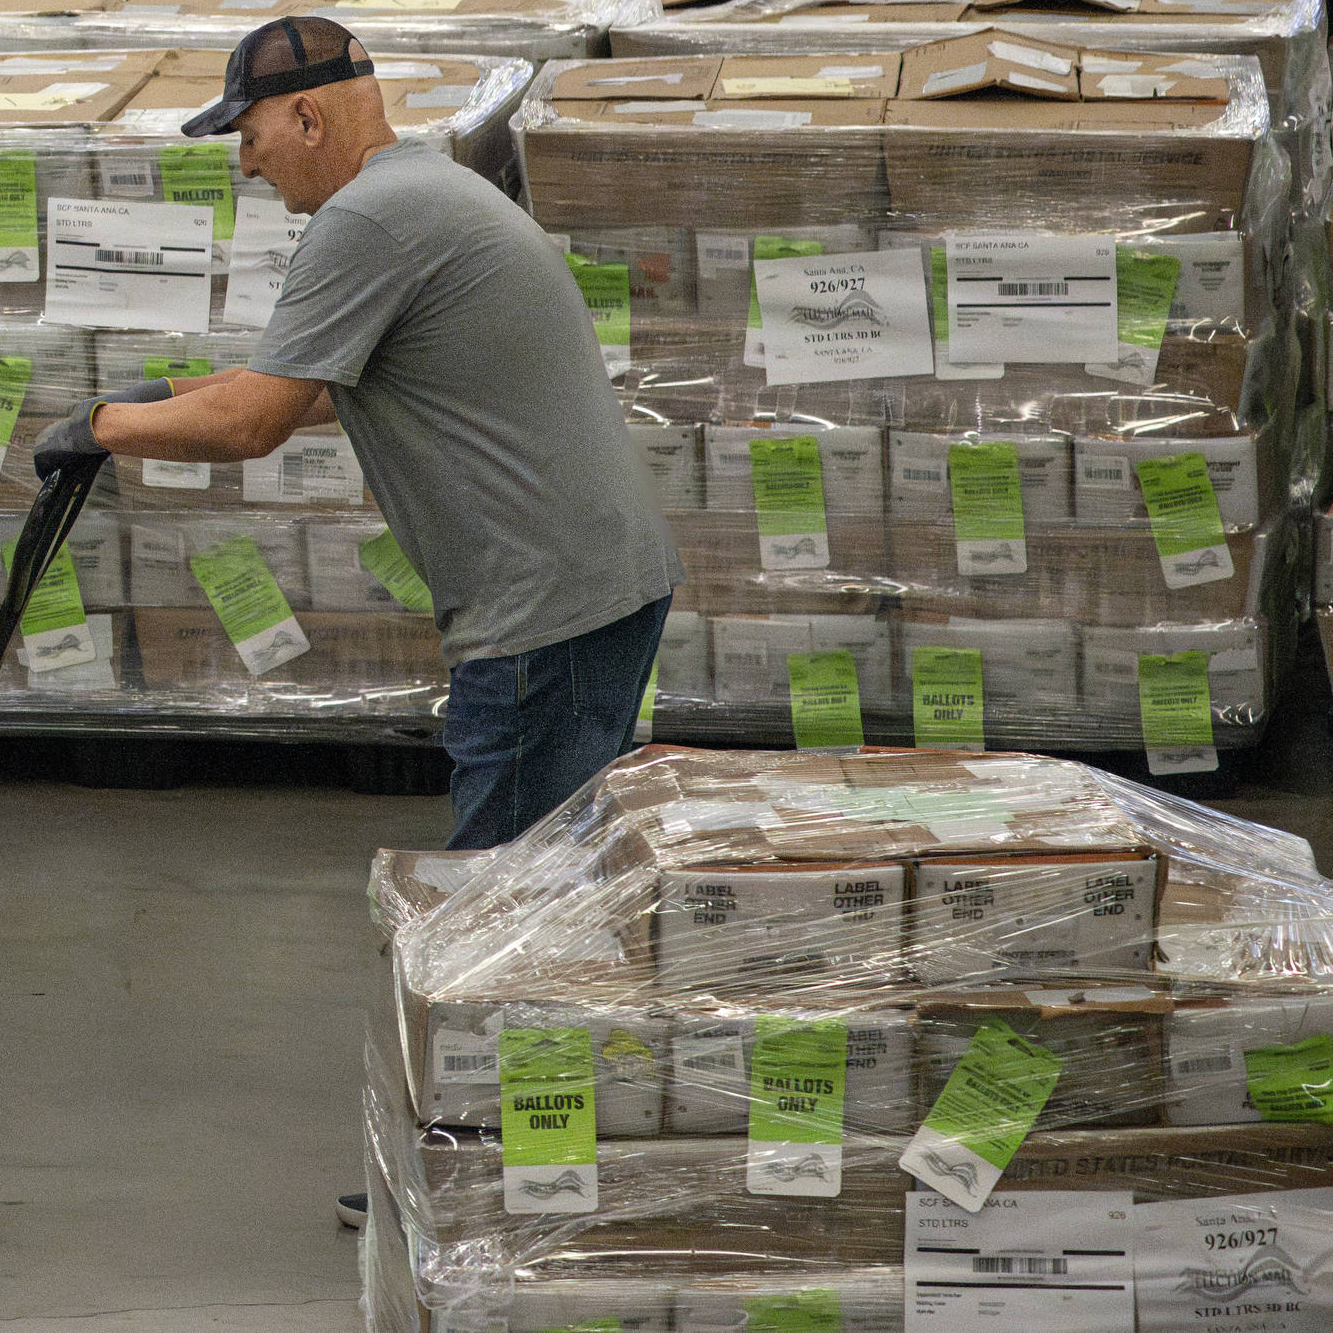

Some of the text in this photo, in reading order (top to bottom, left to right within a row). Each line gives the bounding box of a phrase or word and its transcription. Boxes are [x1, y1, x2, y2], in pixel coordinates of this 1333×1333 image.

[172, 189, 224, 202] BALLOTS
[73, 204, 100, 214] SANTA
[119, 207, 130, 216] CA
[973, 242, 1030, 250] SANTA ANA CA
[851, 264, 865, 274] CA
[810, 277, 866, 294] 926/927
[834, 880, 884, 894] LABEL
[833, 893, 884, 908] OTHER
[1083, 887, 1134, 904] OTHER
[952, 908, 984, 920] END
[1093, 904, 1125, 917] END
[693, 913, 727, 924] END
[762, 1076, 834, 1095] BALLOTS
[513, 1094, 585, 1112] BALLOTS
[778, 1095, 819, 1113] ONLY
[529, 1113, 571, 1130] ONLY
[919, 1199, 1018, 1208] SCF CA
[1107, 1211, 1127, 1220] 926
[1195, 1216, 1226, 1227] Santa
[919, 1219, 969, 1228] STD LTRS
[1204, 1227, 1278, 1250] 926/927
